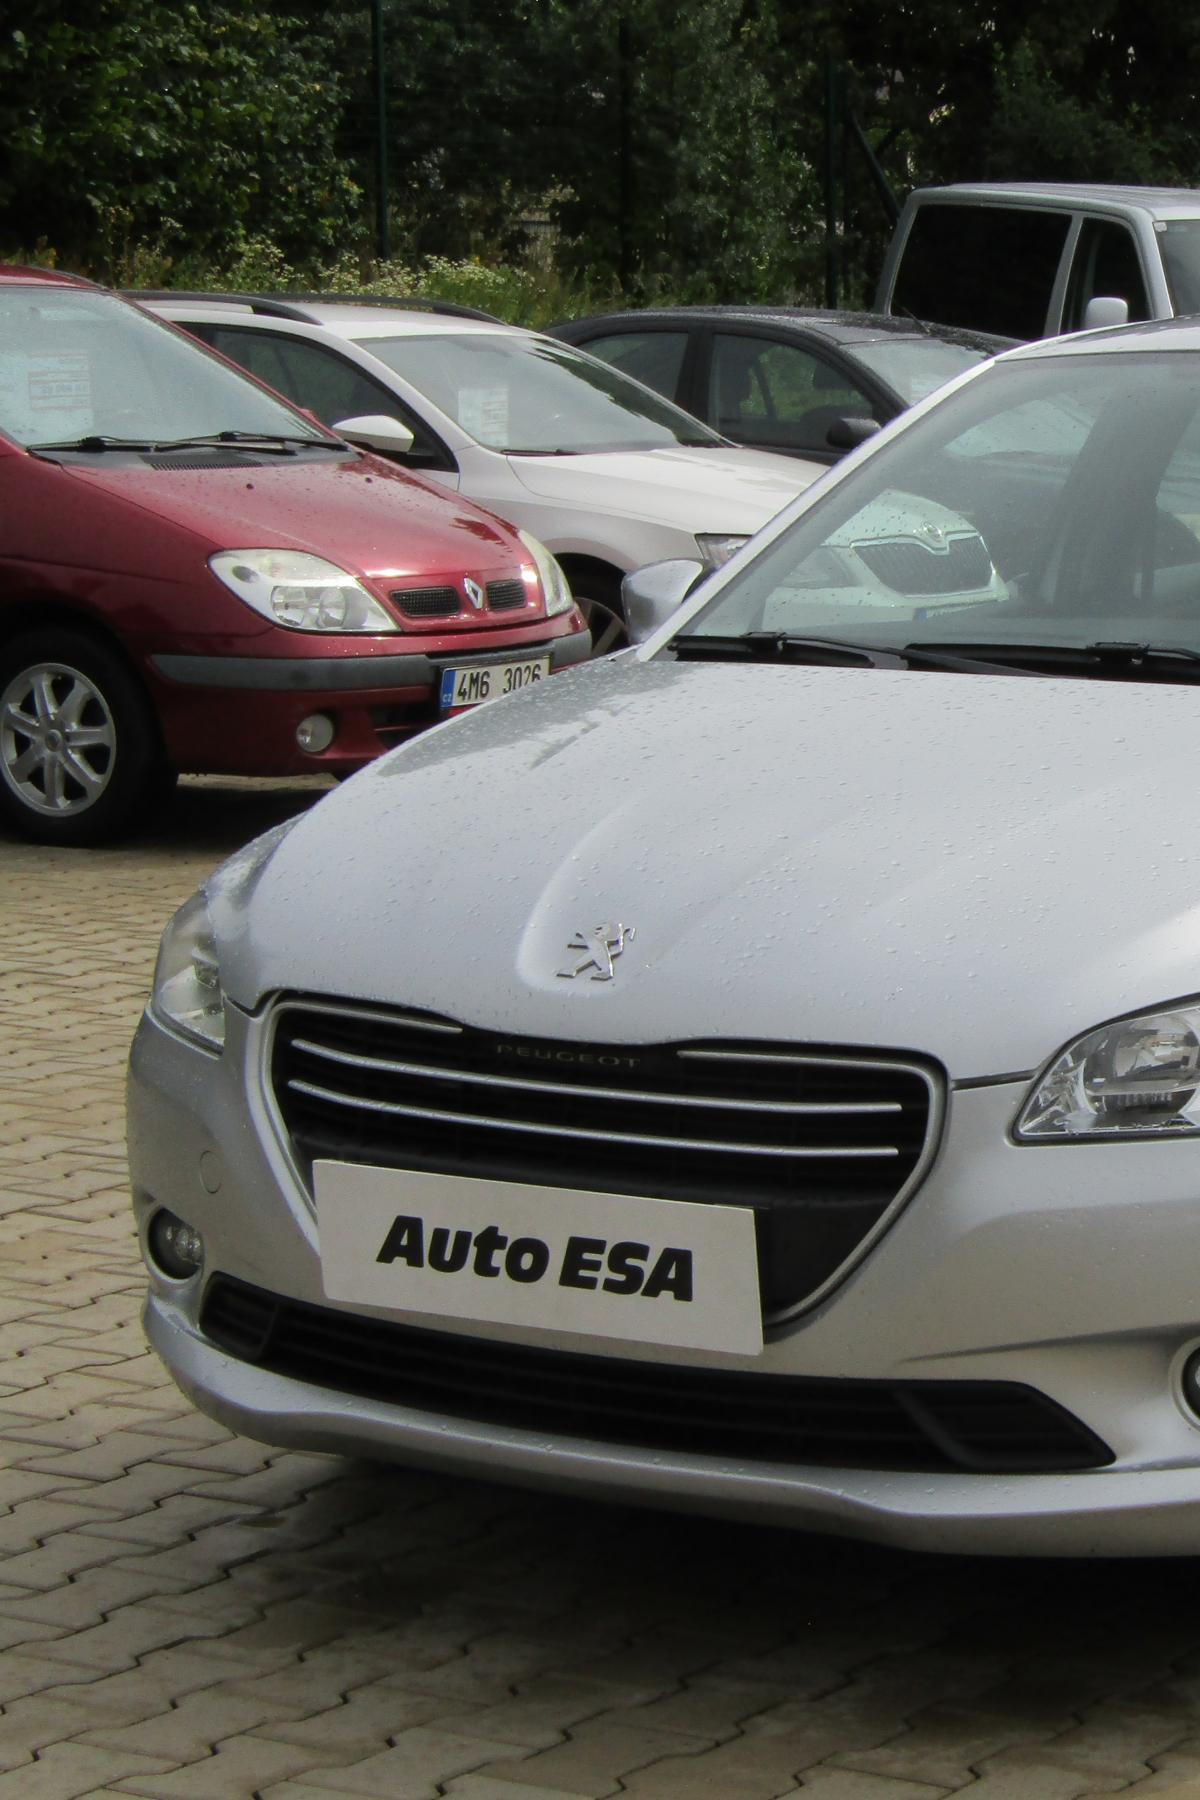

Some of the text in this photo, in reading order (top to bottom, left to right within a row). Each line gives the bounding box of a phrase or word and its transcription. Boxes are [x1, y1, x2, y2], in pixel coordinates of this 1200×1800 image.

[442, 693, 452, 702] CZ
[457, 670, 490, 700] 4M6
[496, 1044, 641, 1068] PEUGEOT
[376, 1215, 693, 1302] Auto ESA
